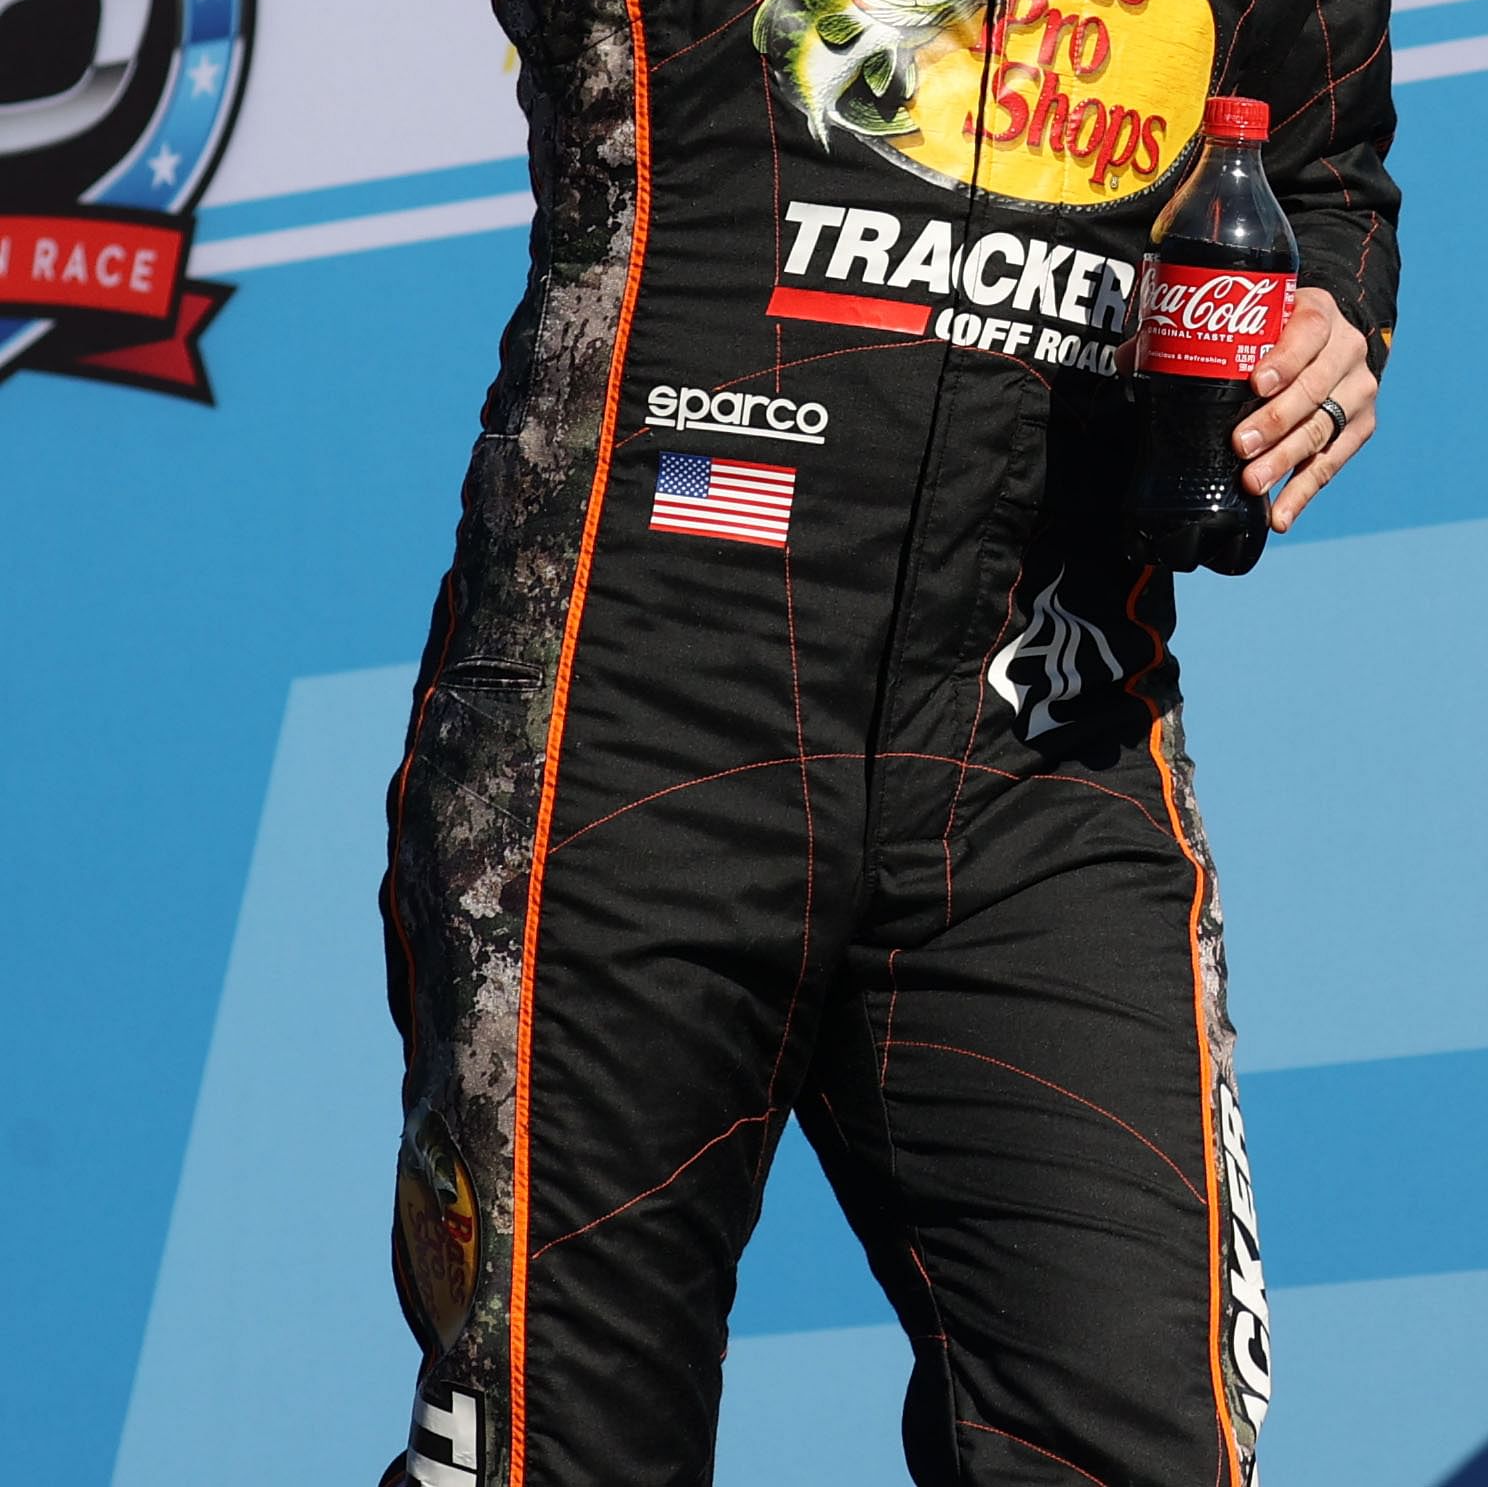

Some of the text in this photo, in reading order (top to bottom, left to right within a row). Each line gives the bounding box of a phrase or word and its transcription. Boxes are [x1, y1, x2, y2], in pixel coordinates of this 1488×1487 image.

[963, 60, 1167, 187] Shops
[32, 236, 157, 292] RACE
[784, 200, 1137, 335] TRACKER
[1140, 267, 1279, 335] Coca-Cola
[1197, 332, 1234, 342] TASTE
[645, 384, 829, 444] sparco
